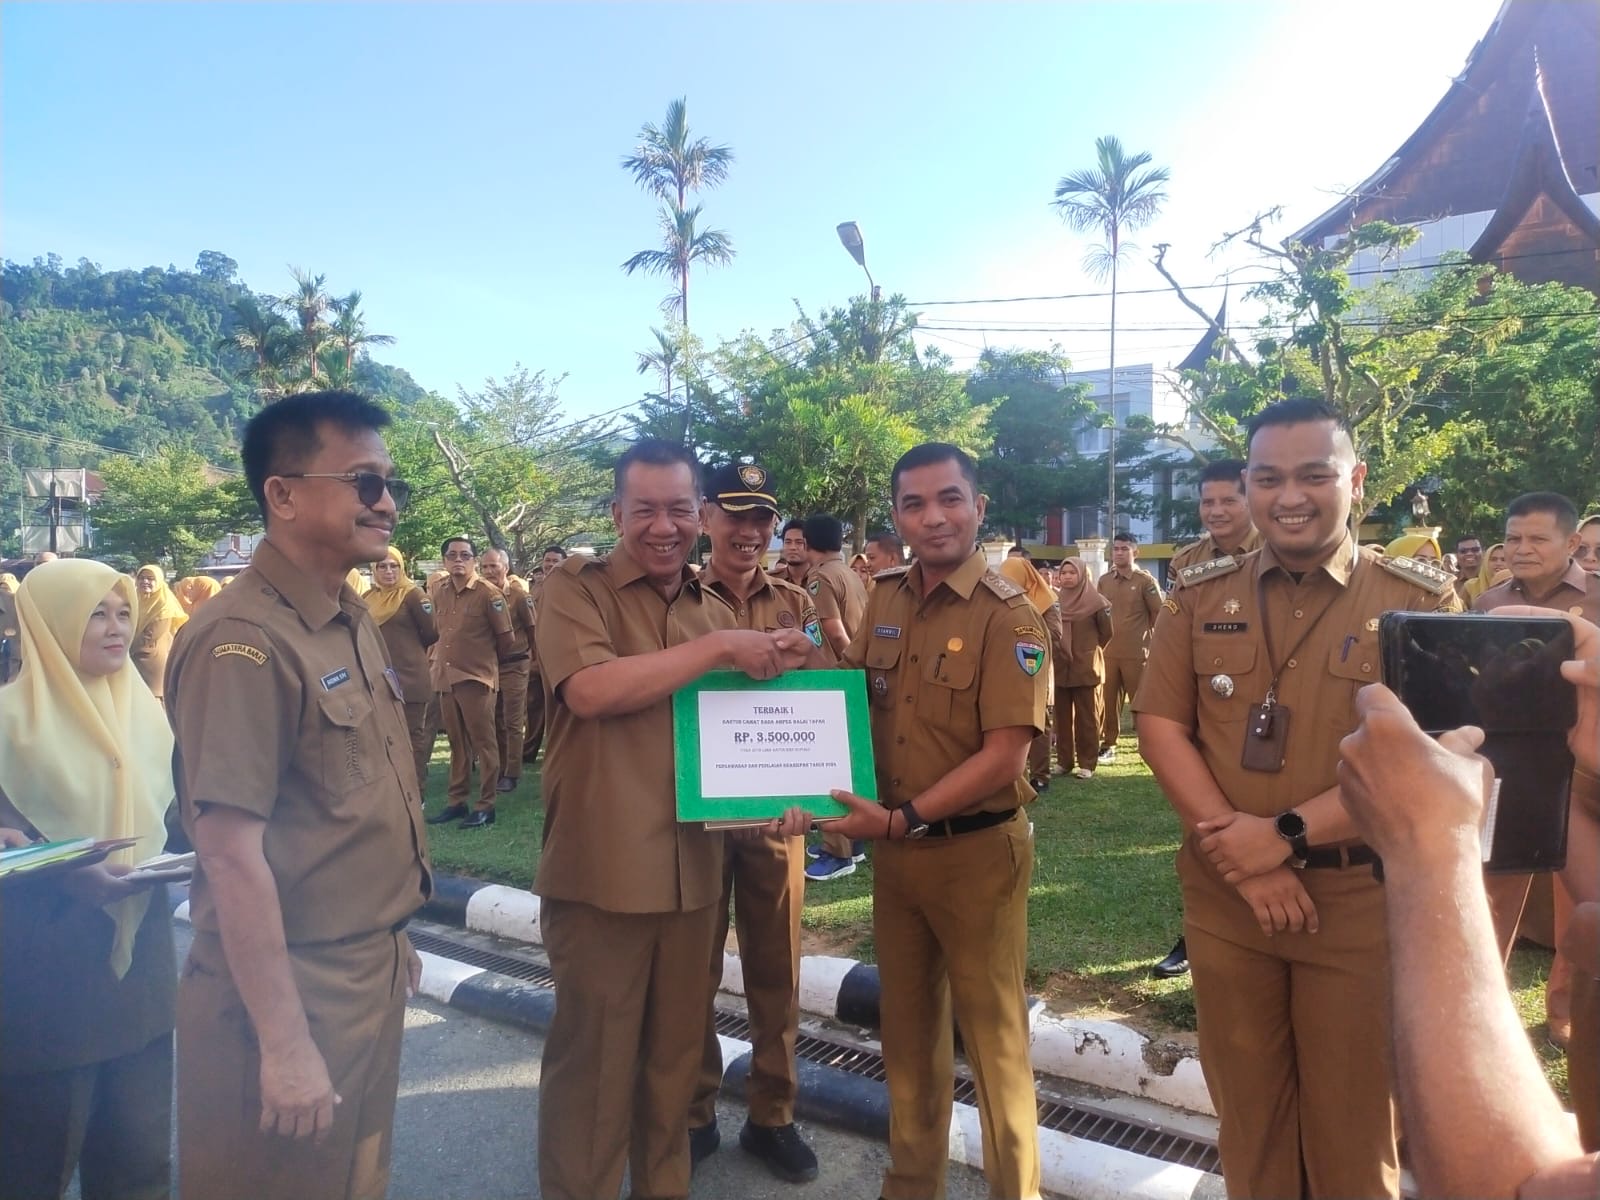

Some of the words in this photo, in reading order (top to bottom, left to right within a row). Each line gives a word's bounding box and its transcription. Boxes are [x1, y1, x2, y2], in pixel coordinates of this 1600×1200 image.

[246, 647, 266, 661] BARAT
[752, 706, 790, 715] TERBAIK
[734, 731, 754, 743] RP.
[756, 731, 816, 742] 3.500.000
